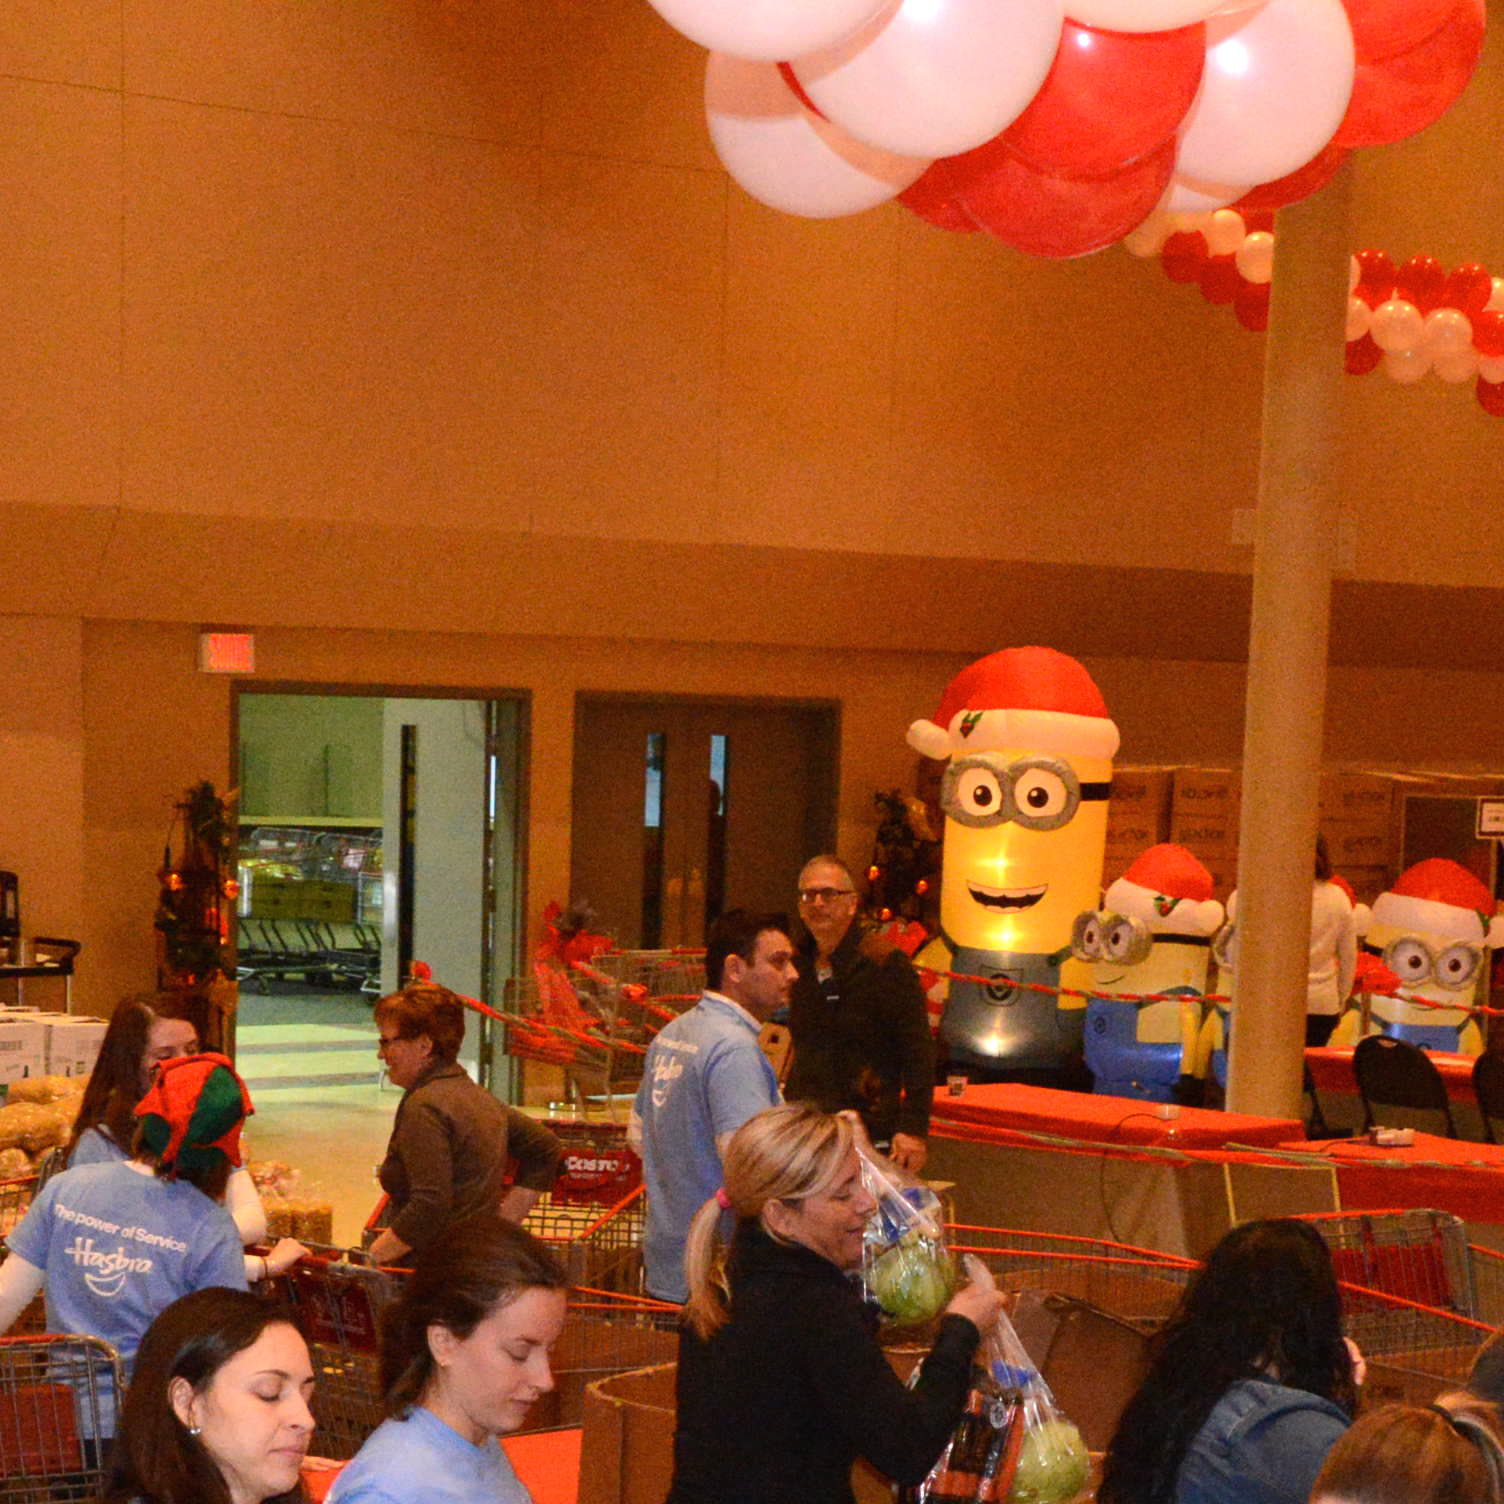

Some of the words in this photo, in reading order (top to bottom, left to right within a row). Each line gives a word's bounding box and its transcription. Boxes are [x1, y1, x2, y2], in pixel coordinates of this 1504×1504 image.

[54, 1203, 76, 1222] The
[76, 1213, 120, 1236] power
[120, 1225, 137, 1238] of
[135, 1227, 188, 1253] Service
[64, 1236, 153, 1275] Hasbro
